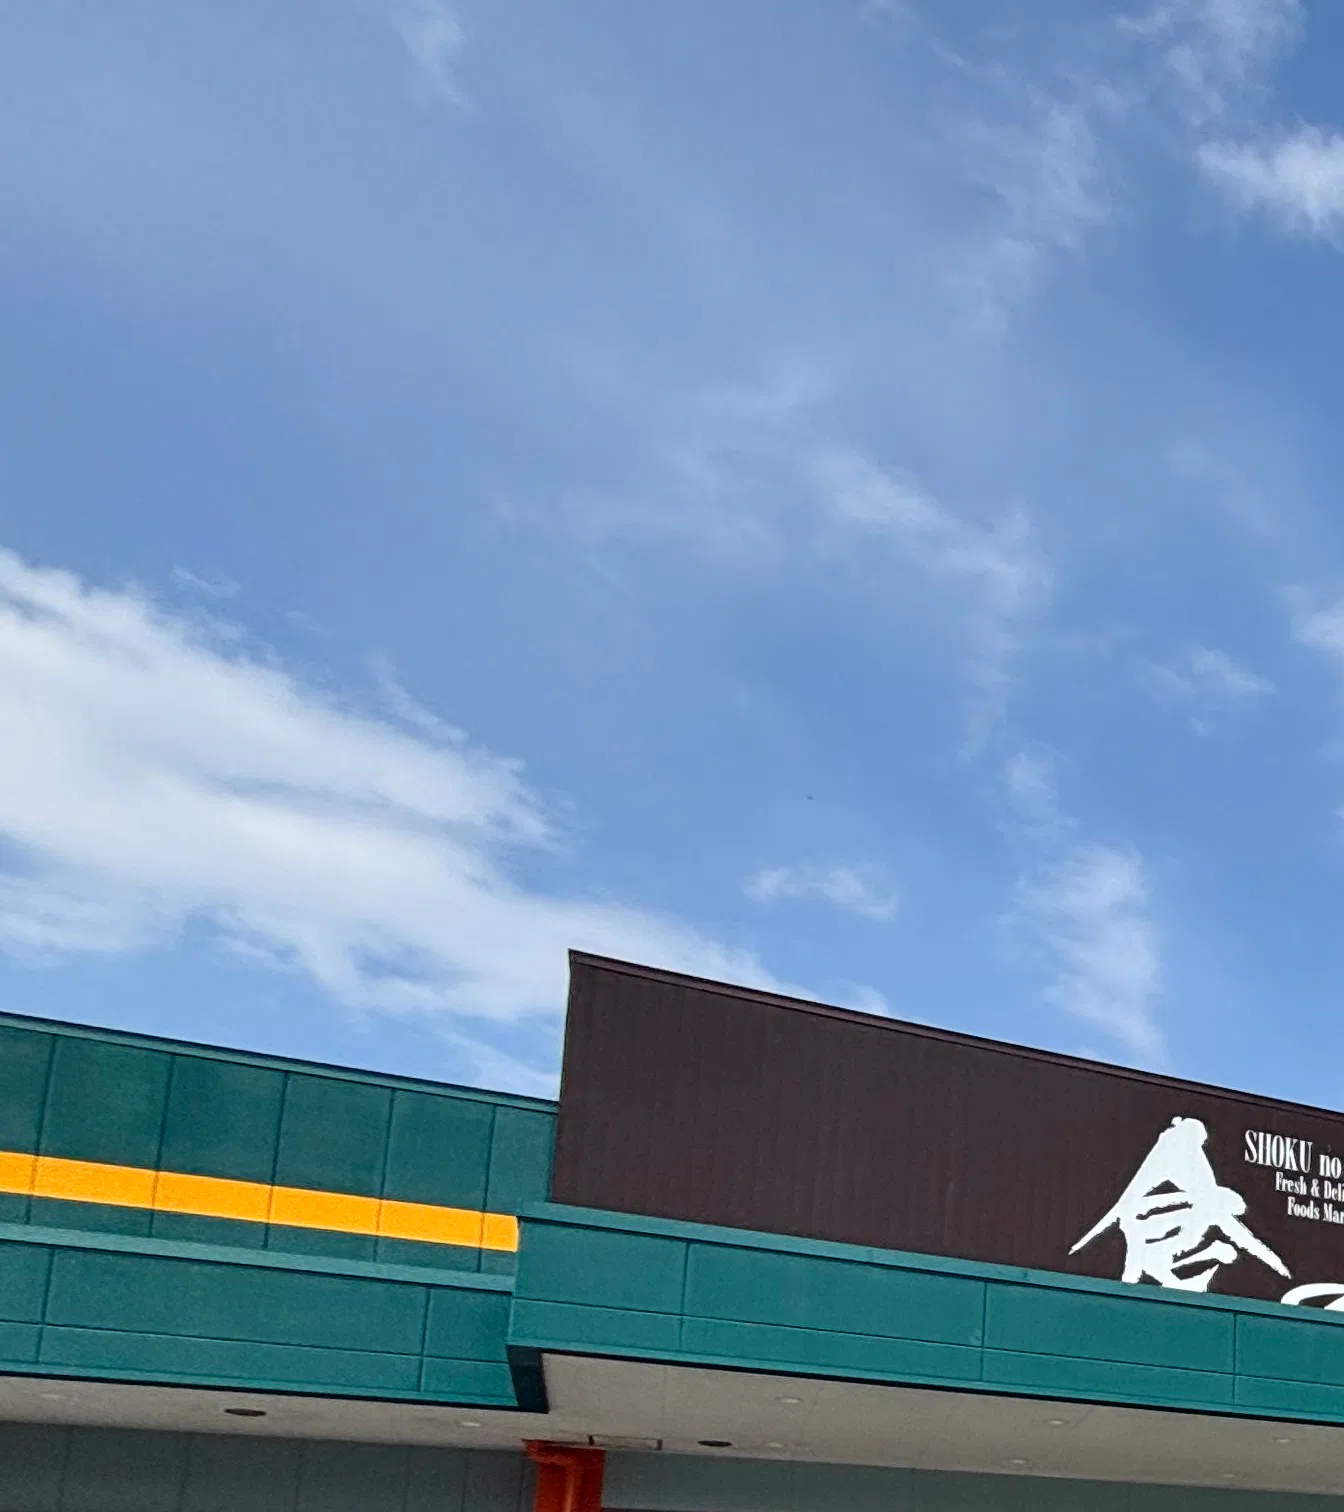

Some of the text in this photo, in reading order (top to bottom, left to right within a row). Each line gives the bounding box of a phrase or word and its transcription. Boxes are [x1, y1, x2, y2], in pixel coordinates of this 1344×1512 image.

[1244, 1129, 1314, 1174] SHOKU
[1319, 1154, 1343, 1180] no
[1275, 1171, 1308, 1196] Fresh
[1311, 1178, 1321, 1198] &
[1287, 1196, 1321, 1221] Foods
